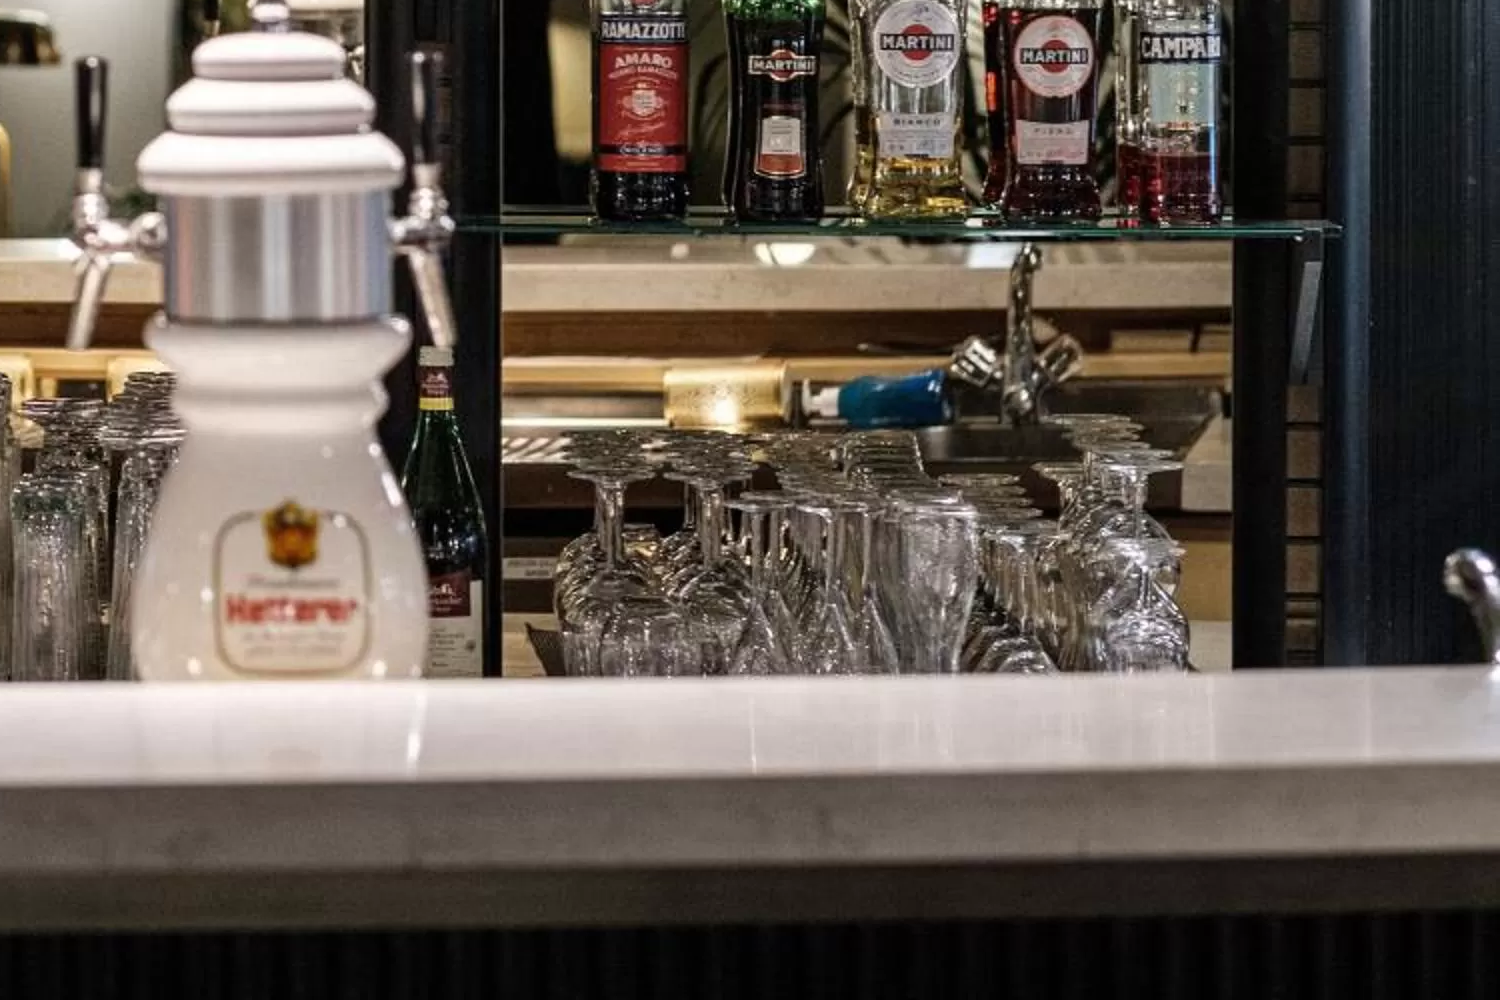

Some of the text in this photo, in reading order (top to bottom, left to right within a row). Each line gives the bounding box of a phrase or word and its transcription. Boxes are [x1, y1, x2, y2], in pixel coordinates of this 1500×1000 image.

[601, 21, 685, 39] RAMAZZOTTI
[884, 34, 955, 50] MARTINI
[614, 51, 673, 70] AMARO
[1022, 49, 1087, 64] MARTINI
[753, 59, 812, 71] MARTINI
